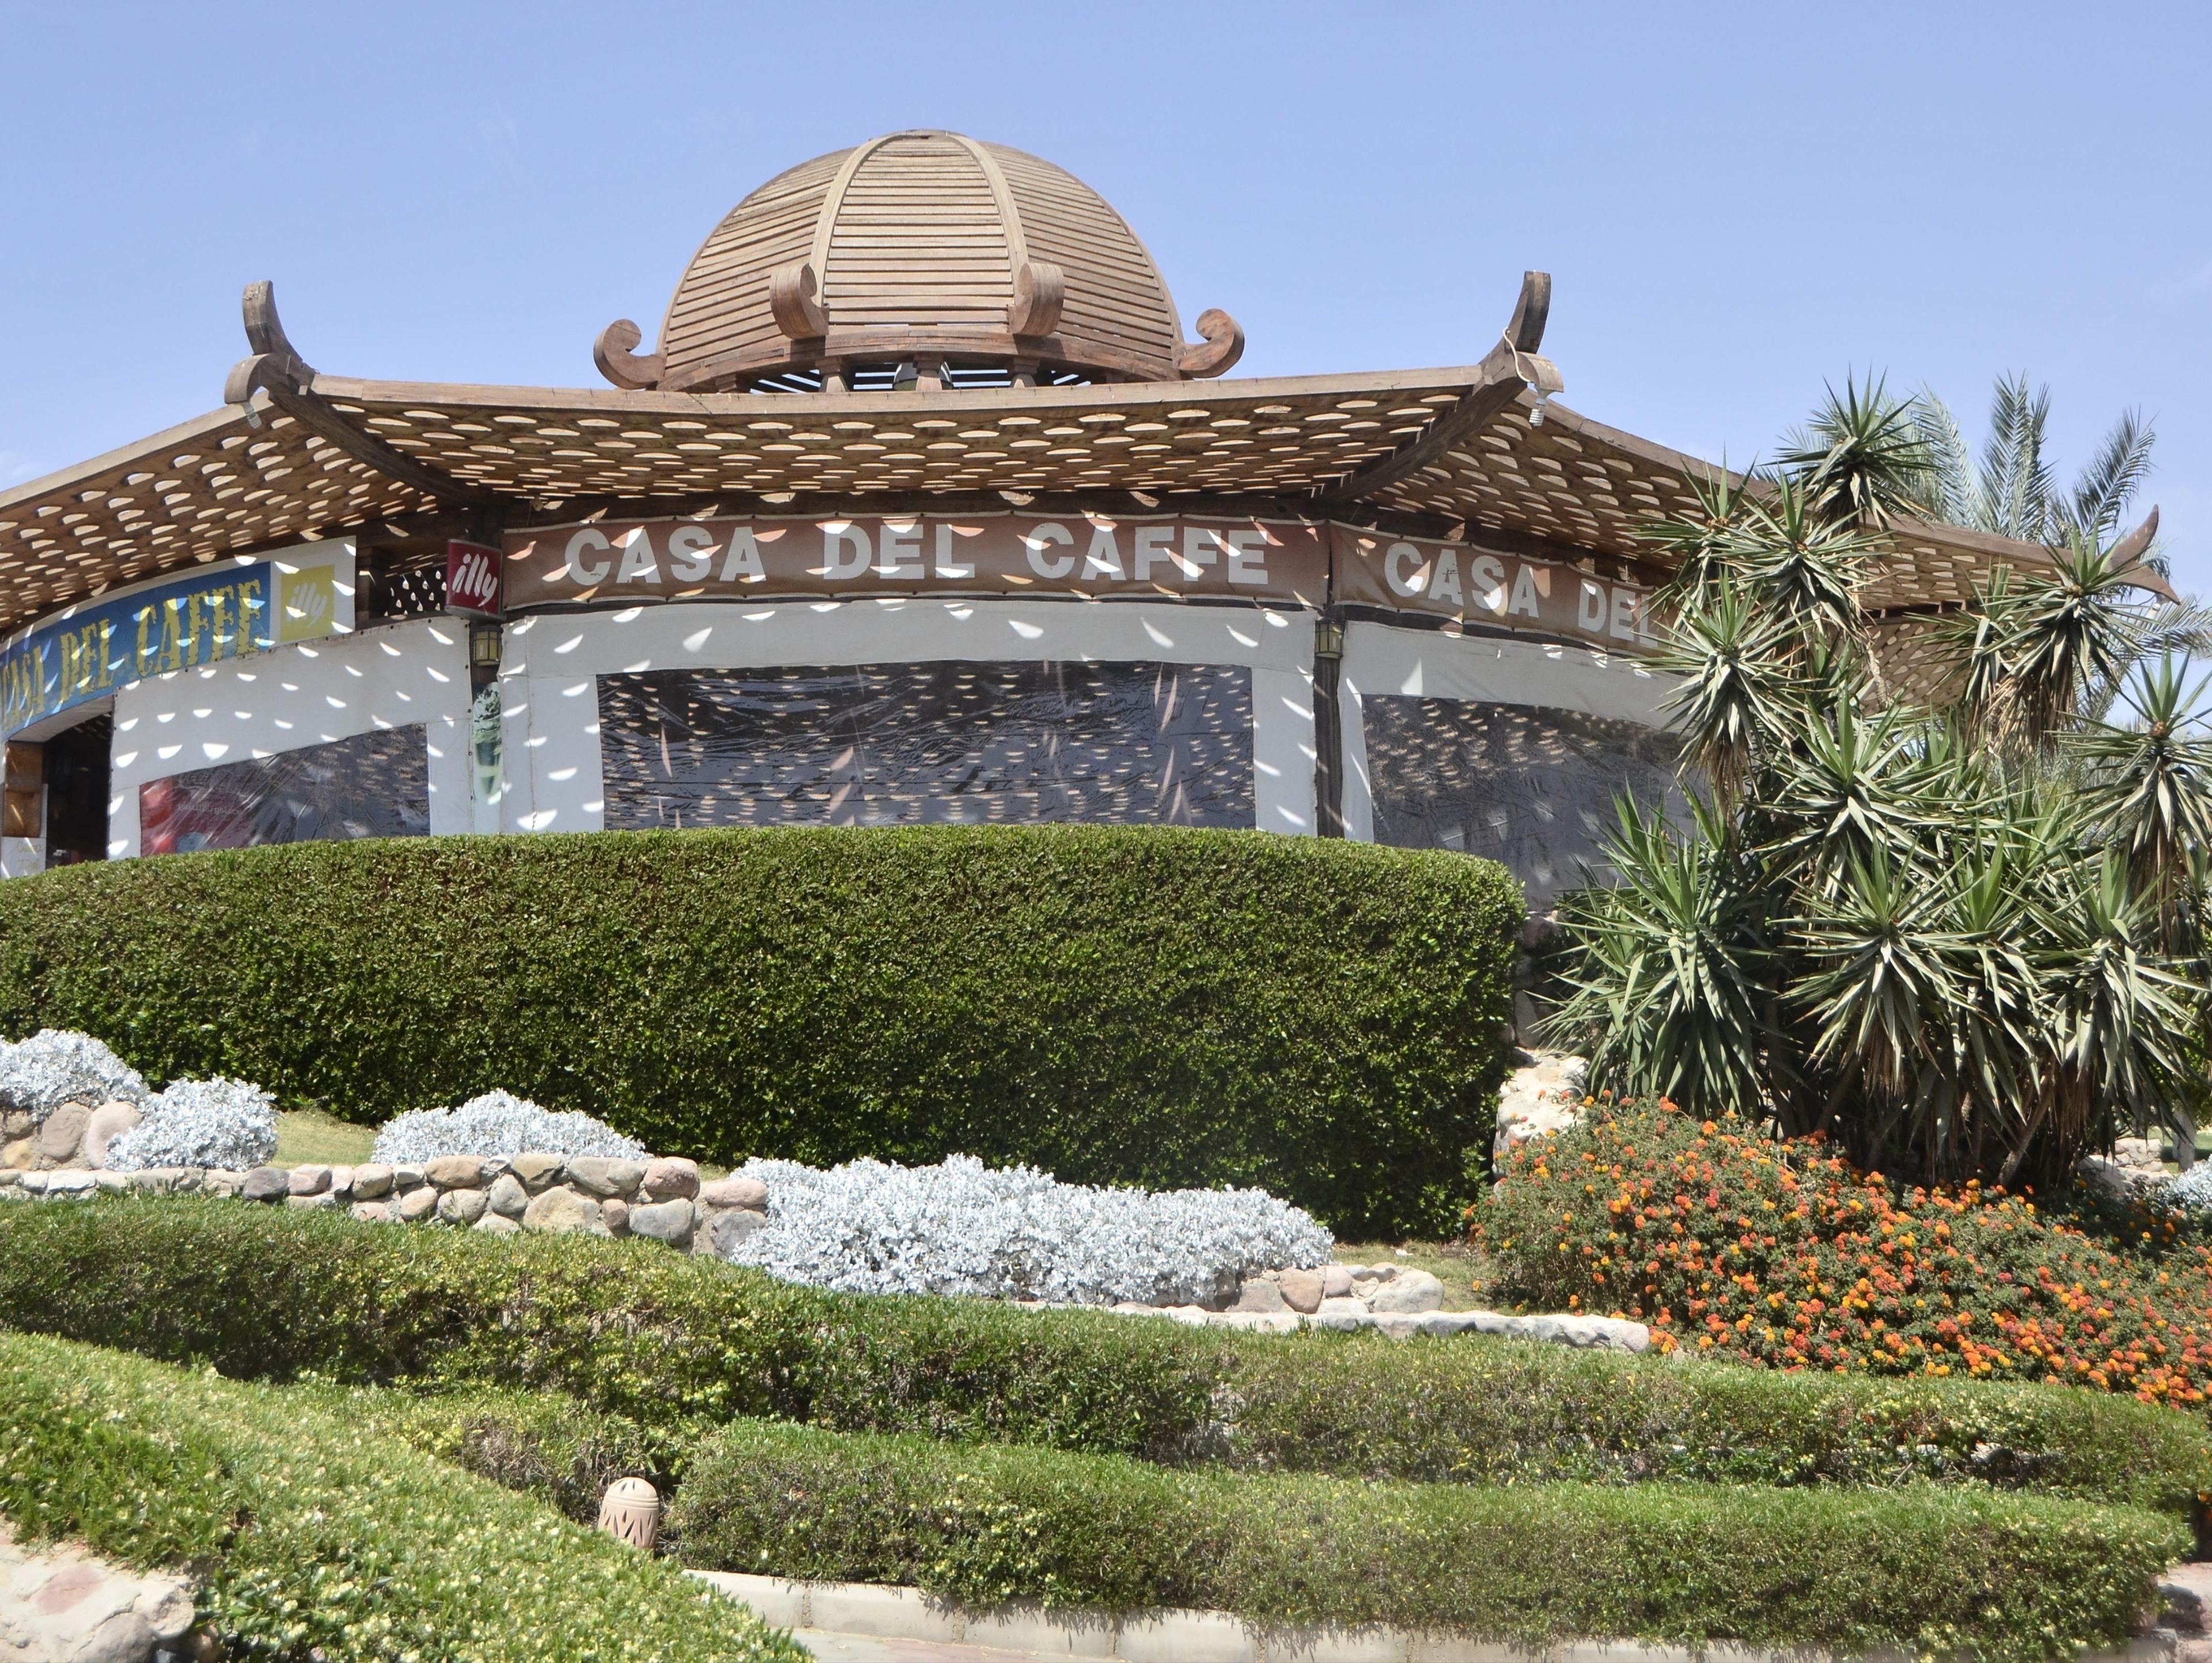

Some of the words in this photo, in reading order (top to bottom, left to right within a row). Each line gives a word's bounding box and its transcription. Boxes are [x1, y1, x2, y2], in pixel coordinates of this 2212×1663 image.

[452, 553, 498, 607] illy
[565, 525, 766, 586] CASA
[823, 522, 975, 579] DEL
[1026, 522, 1268, 585] CAFFE
[286, 582, 329, 629] illy
[1384, 541, 1539, 619] CASA
[1578, 578, 1658, 647] DEL
[60, 618, 115, 703] DEL
[136, 579, 263, 677] CAFFE
